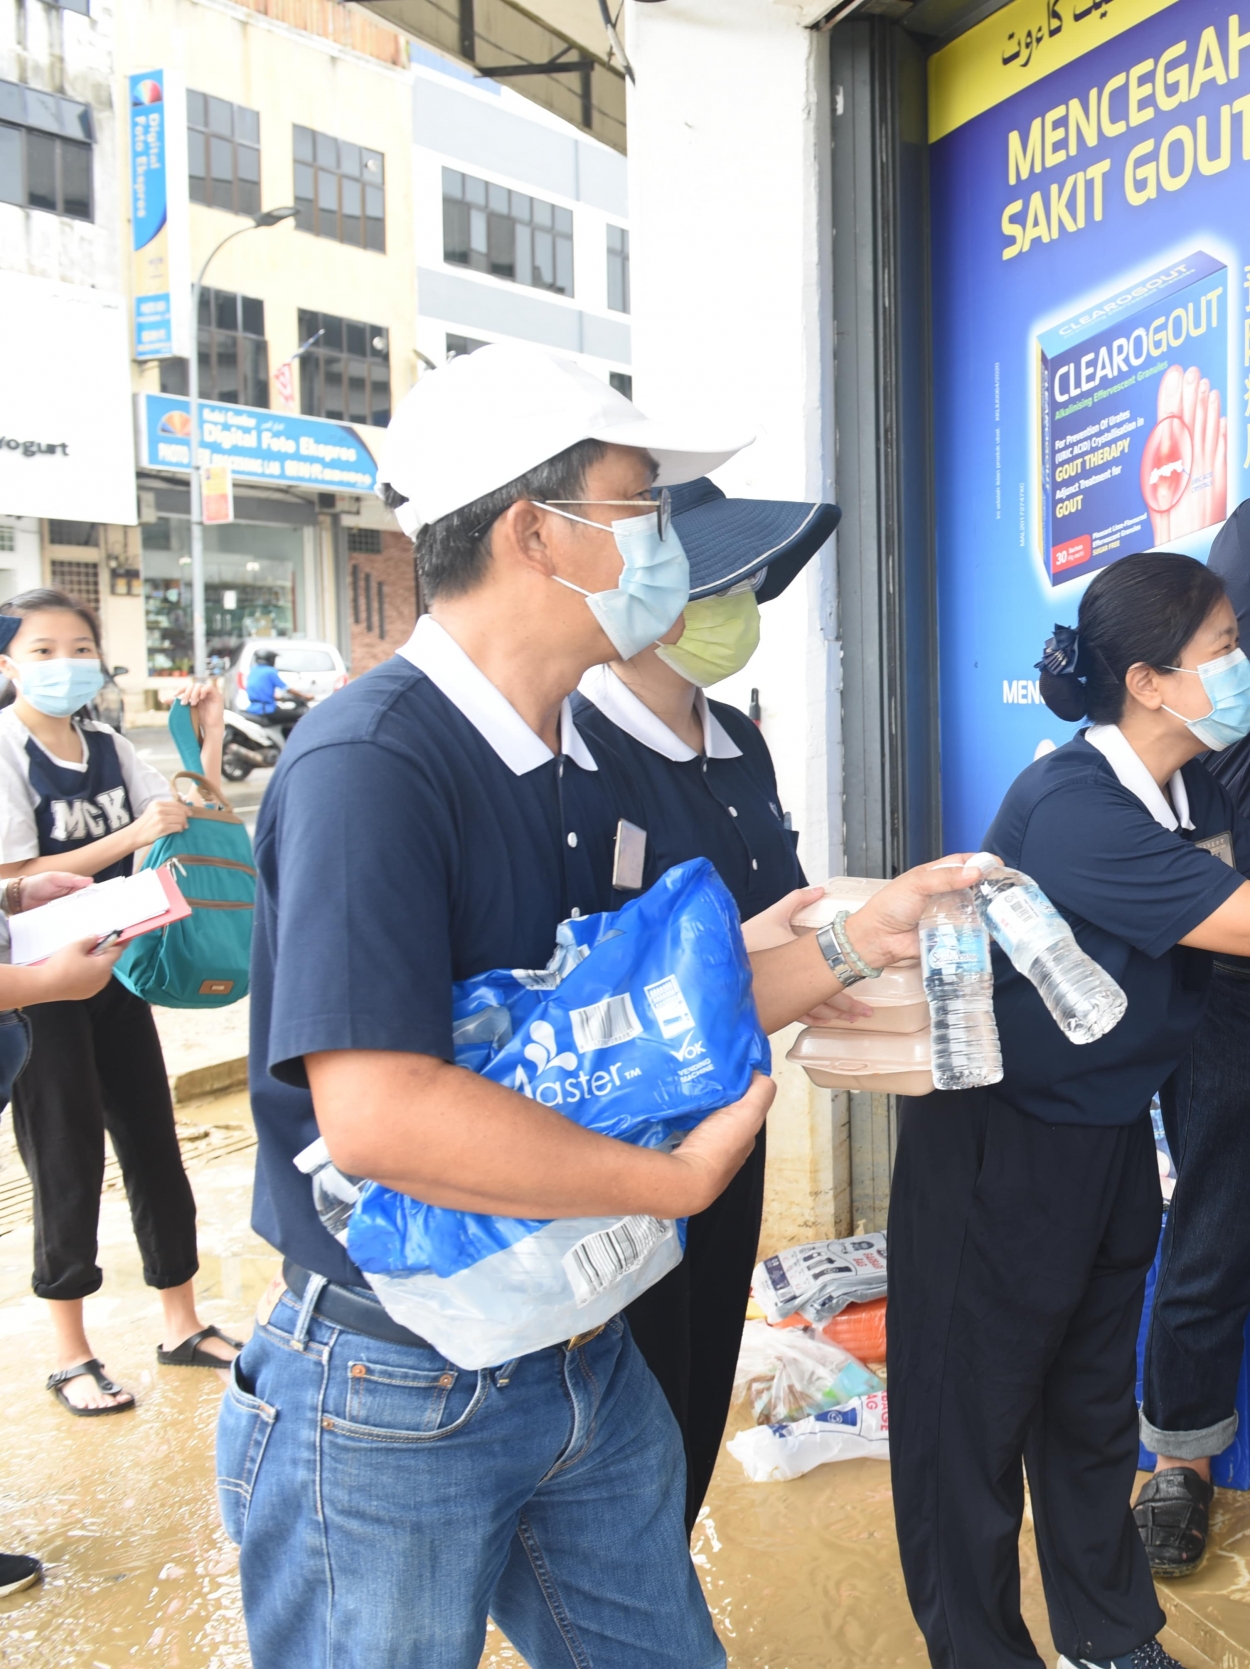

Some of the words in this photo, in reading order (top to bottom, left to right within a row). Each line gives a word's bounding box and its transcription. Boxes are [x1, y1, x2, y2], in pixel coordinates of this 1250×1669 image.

[1001, 158, 1112, 261] SAKIT
[1058, 263, 1189, 336] CLEAROGOUT
[1053, 286, 1223, 403] CLEAROGOUT
[1093, 375, 1136, 402] Effervescent
[1137, 361, 1168, 381] Granules
[203, 423, 258, 449] Digital
[261, 430, 297, 454] Foto
[299, 436, 357, 462] Ekspres
[1066, 424, 1100, 446] Prevention
[1109, 410, 1131, 426] Urates
[1055, 458, 1083, 482] GOUT
[1084, 437, 1131, 470] THERAPY
[1055, 482, 1080, 500] Adjunct
[1079, 469, 1112, 490] Treatment
[1111, 465, 1122, 477] for
[1055, 495, 1084, 518] GOUT
[1055, 550, 1068, 566] 30
[1003, 680, 1046, 704] MEN
[50, 785, 131, 841] MCK
[677, 1057, 712, 1076] VENDING
[679, 1063, 715, 1083] MACHINE
